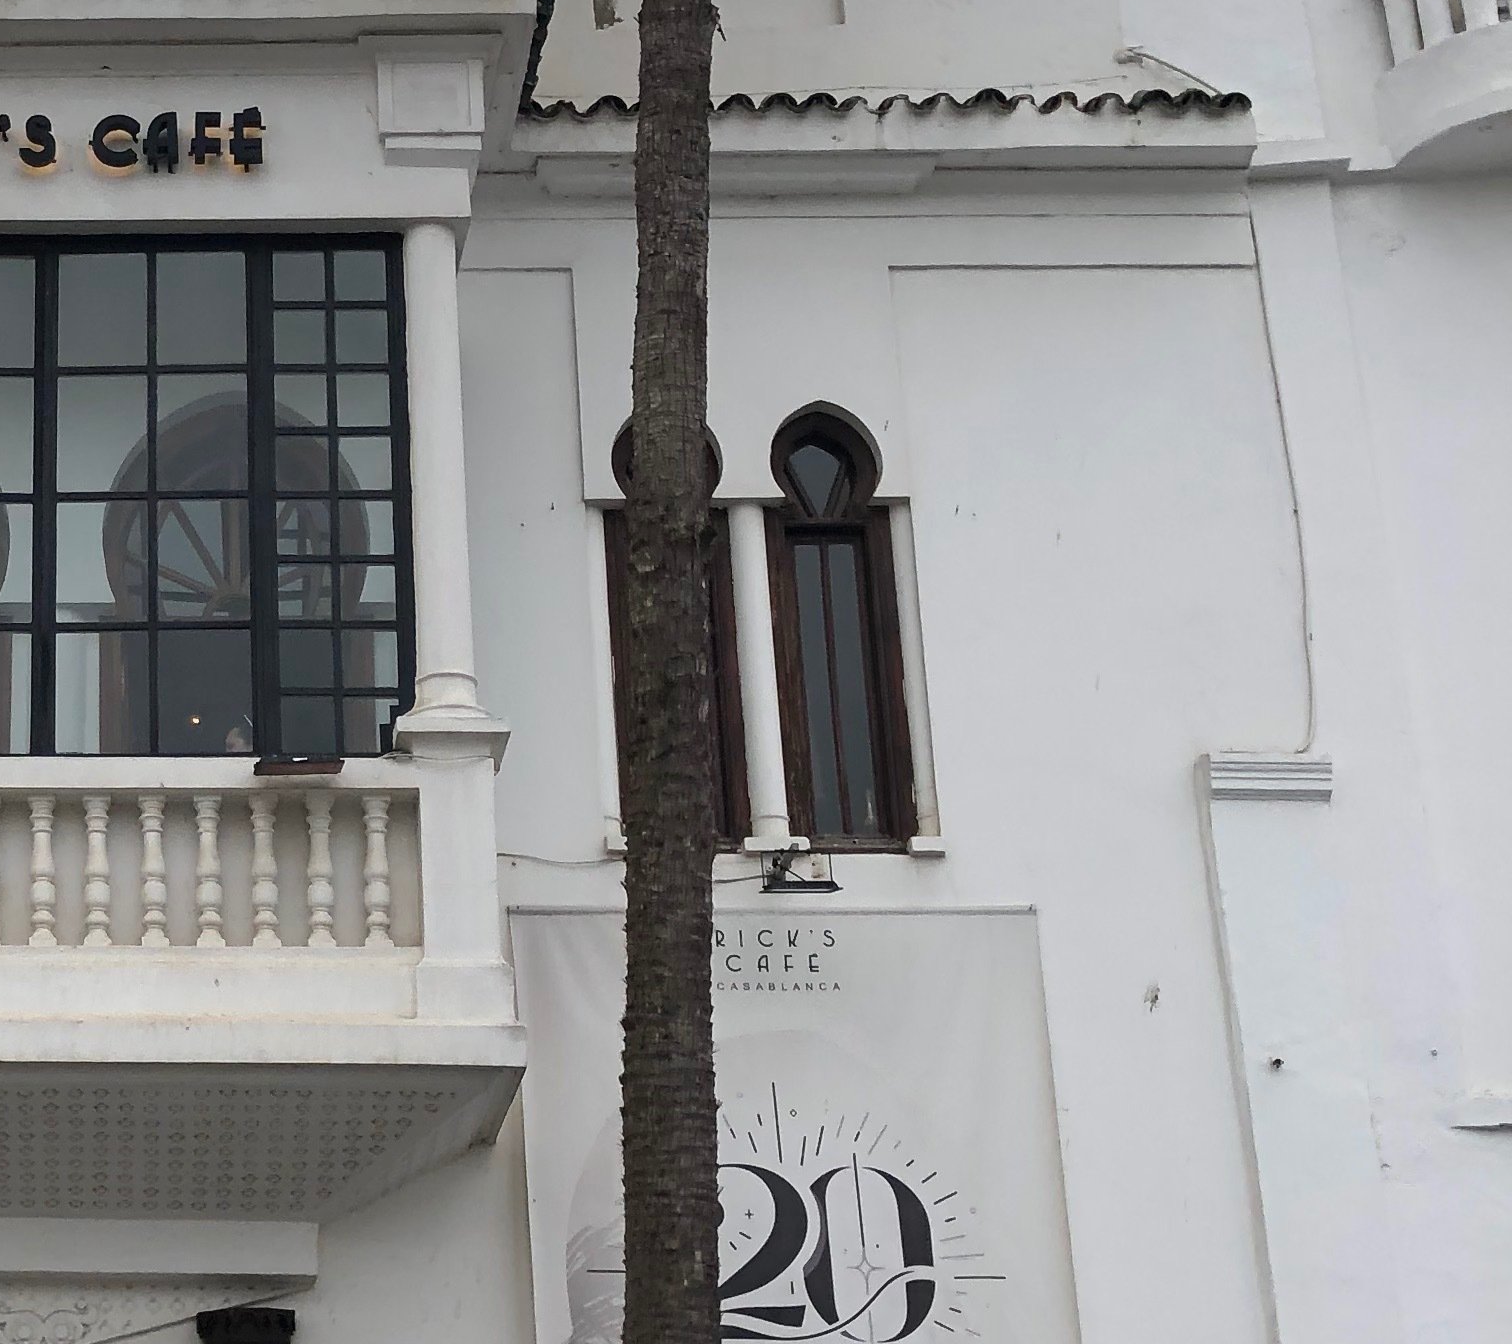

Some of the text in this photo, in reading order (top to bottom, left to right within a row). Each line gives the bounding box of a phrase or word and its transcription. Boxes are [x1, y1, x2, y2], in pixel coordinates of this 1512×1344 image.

[715, 929, 835, 948] RICK'S
[716, 982, 841, 991] CASABLANCA
[718, 1163, 936, 1343] 20
